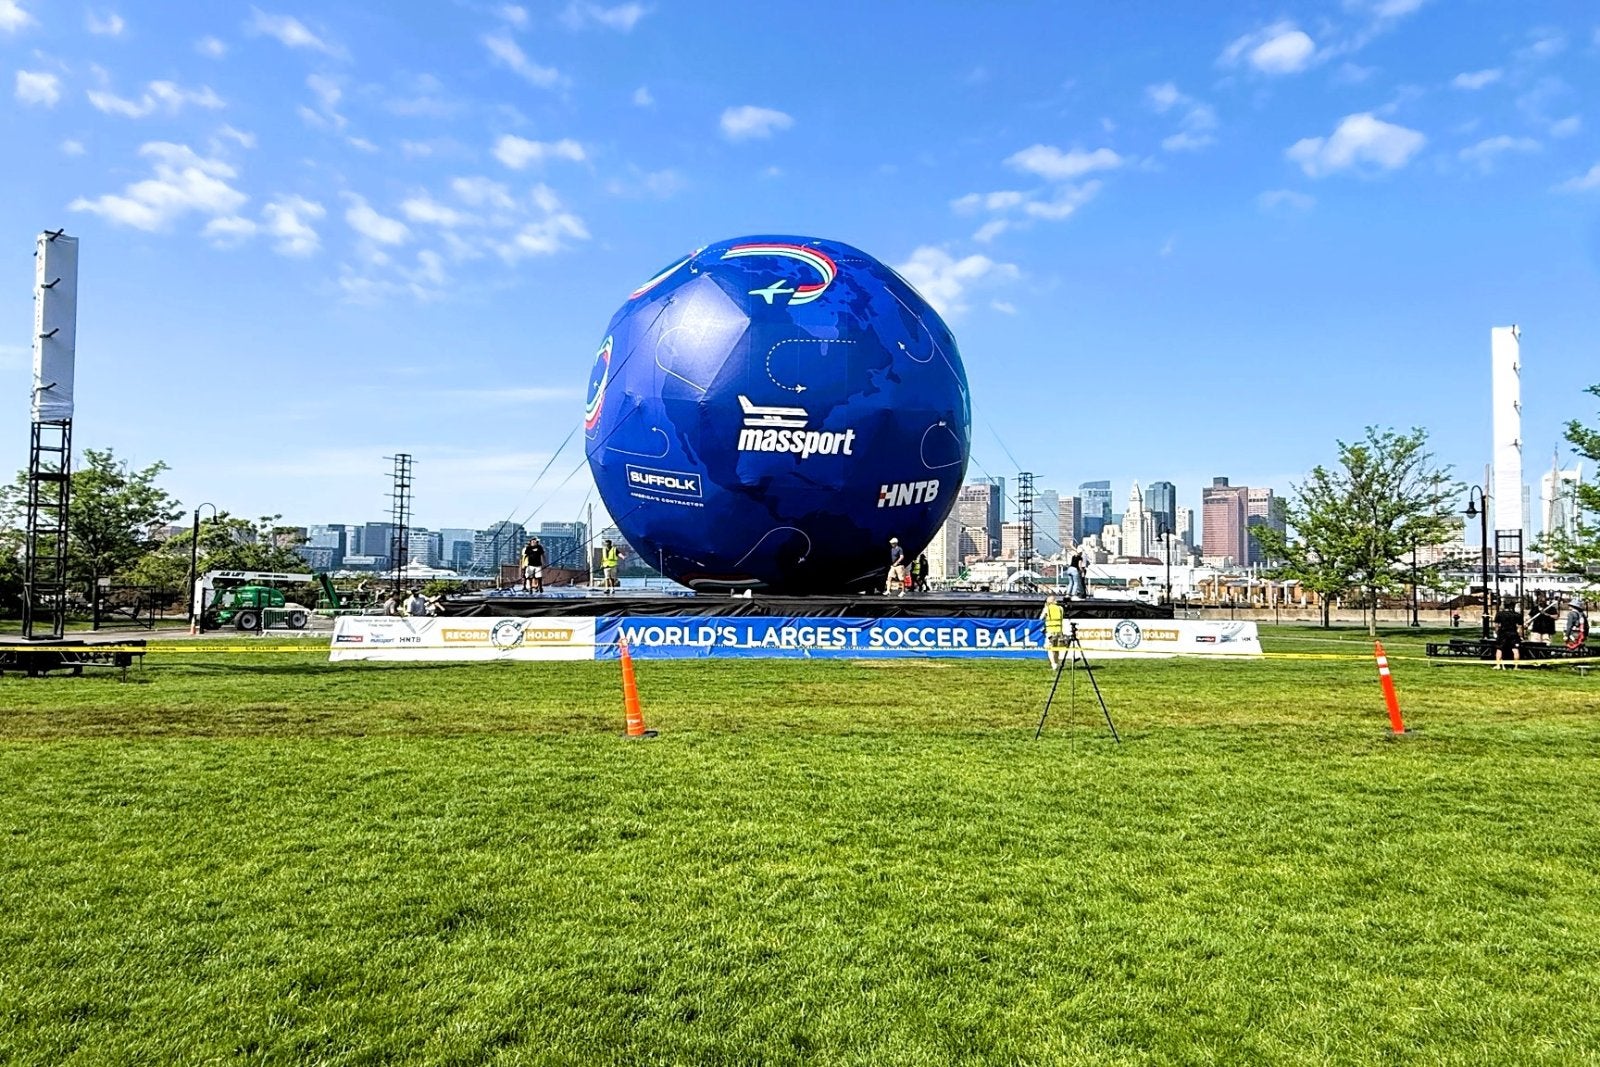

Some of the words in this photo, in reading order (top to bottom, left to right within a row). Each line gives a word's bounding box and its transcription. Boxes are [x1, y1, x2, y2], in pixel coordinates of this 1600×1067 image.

[737, 428, 856, 459] massport
[630, 471, 697, 491] SUFFOLK
[630, 492, 660, 502] AMERICA'S
[661, 498, 705, 508] CONTRACTOR
[877, 479, 939, 508] HNTB
[446, 631, 488, 640] RECORD
[527, 631, 569, 640] HOLDER
[618, 626, 737, 646] WORLD'S
[747, 626, 861, 647] LARGEST
[869, 626, 968, 647] SOCCER
[975, 628, 1038, 647] BALL
[1077, 631, 1112, 640] RECORD
[1143, 630, 1176, 640] HOLDER
